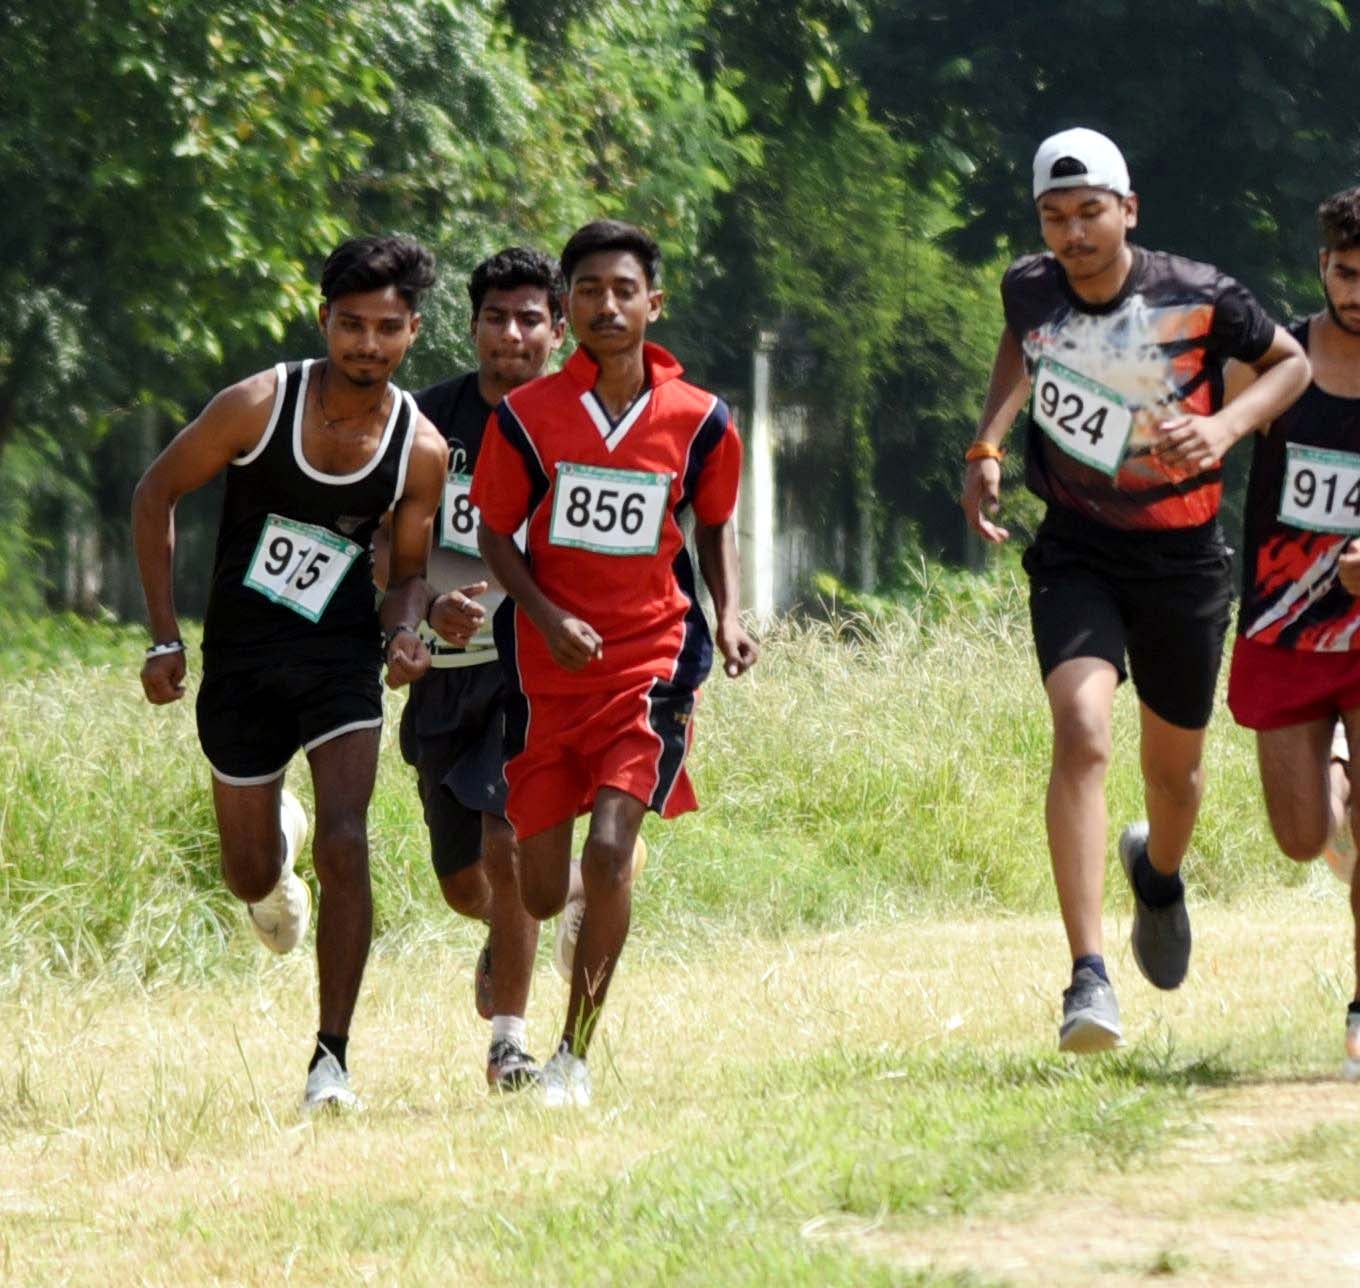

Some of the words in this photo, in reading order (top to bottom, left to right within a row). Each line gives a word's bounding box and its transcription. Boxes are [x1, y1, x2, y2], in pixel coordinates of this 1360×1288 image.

[1041, 381, 1108, 445] 924
[451, 494, 480, 535] 8
[566, 486, 647, 535] 856
[264, 537, 330, 590] 915
